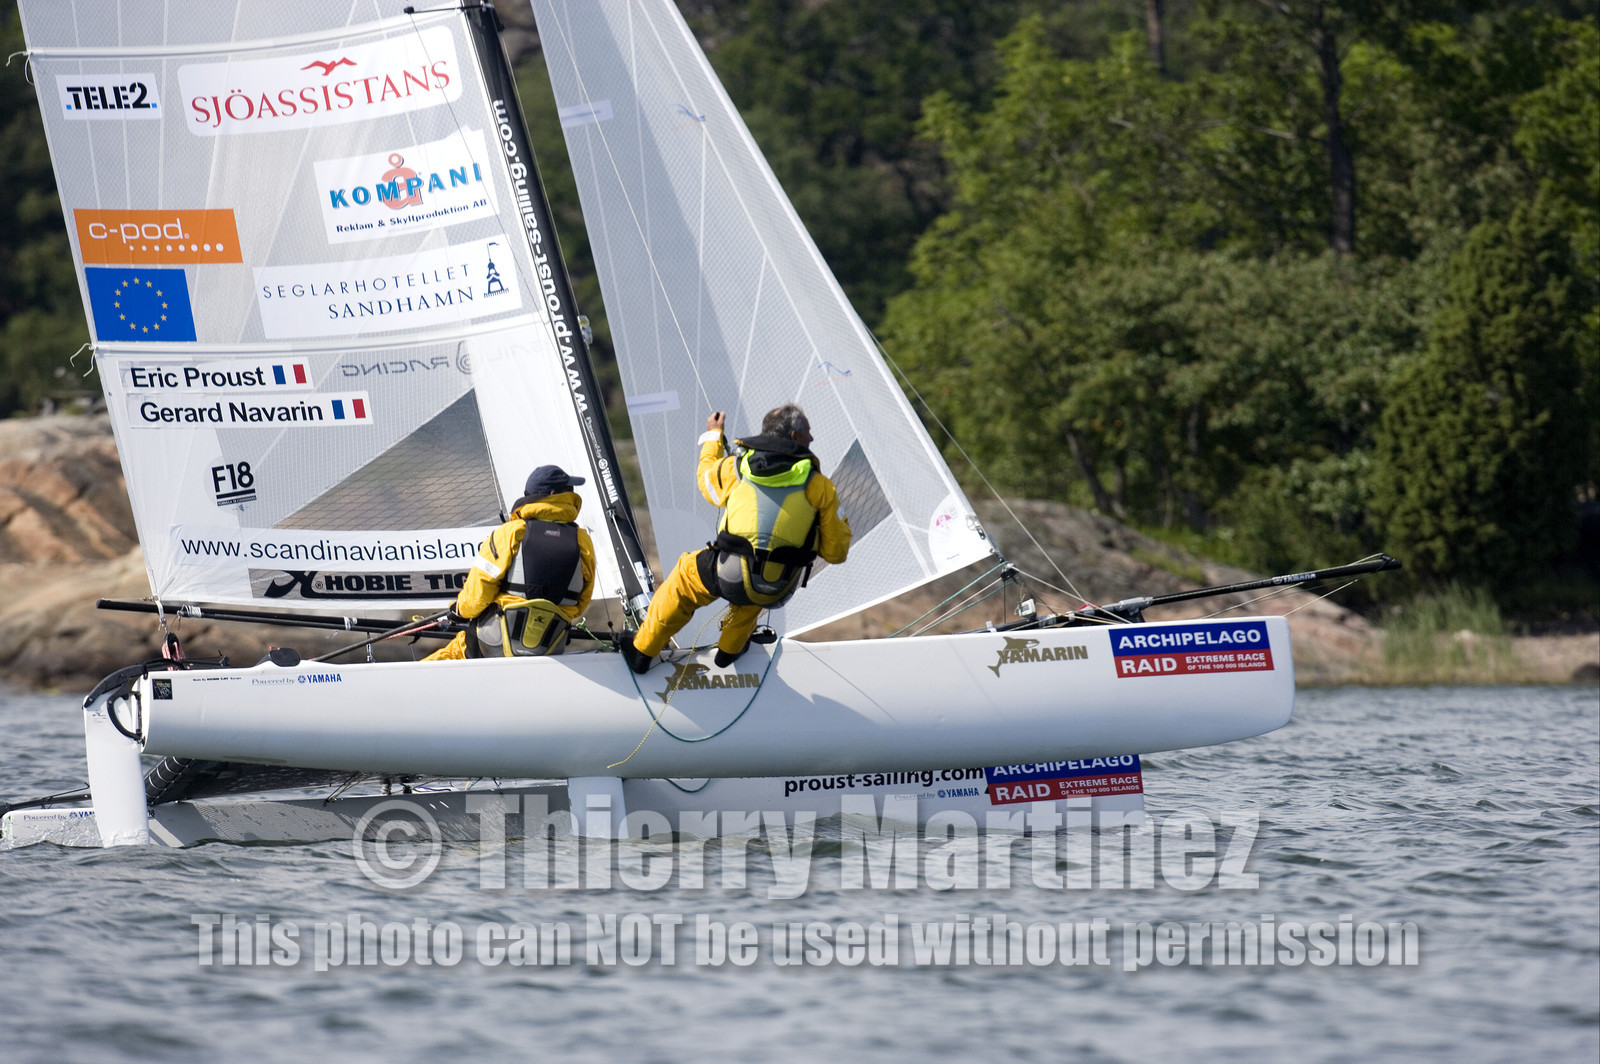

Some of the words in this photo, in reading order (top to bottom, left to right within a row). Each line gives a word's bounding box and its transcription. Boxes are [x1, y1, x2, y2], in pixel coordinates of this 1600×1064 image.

[191, 60, 451, 128] SJÖASSISTANS
[329, 162, 482, 209] KOMPANI
[336, 221, 374, 233] Reklam
[377, 219, 386, 228] &
[472, 199, 487, 209] AB
[263, 263, 469, 299] SEGLARHOTELLET
[328, 286, 475, 320] SANDHAMN
[130, 366, 179, 388] Eric
[184, 366, 266, 387] Proust
[140, 401, 223, 423] Gerard
[229, 401, 323, 422] Navarin
[212, 461, 254, 493] F18
[601, 467, 618, 504] YAMAHA
[324, 575, 412, 591] HOBIE
[1119, 629, 1261, 649] ARCHIPELAGO
[997, 645, 1088, 663] YAMARIN
[1121, 657, 1178, 674] RAID
[1185, 654, 1235, 664] EXTREME
[1237, 653, 1266, 662] RACE
[1237, 661, 1267, 669] ISLANDS
[251, 677, 286, 686] Powered
[286, 677, 296, 686] by
[307, 673, 342, 684] YAMAHA
[665, 674, 760, 691] YAMARIN
[993, 755, 1134, 777] ARCHIPELAGO
[784, 767, 984, 797] proust-sailing.com
[946, 787, 979, 798] YAMAHA
[995, 783, 1051, 801] RAID
[1059, 778, 1108, 789] EXTREME
[1110, 776, 1139, 785] RACE
